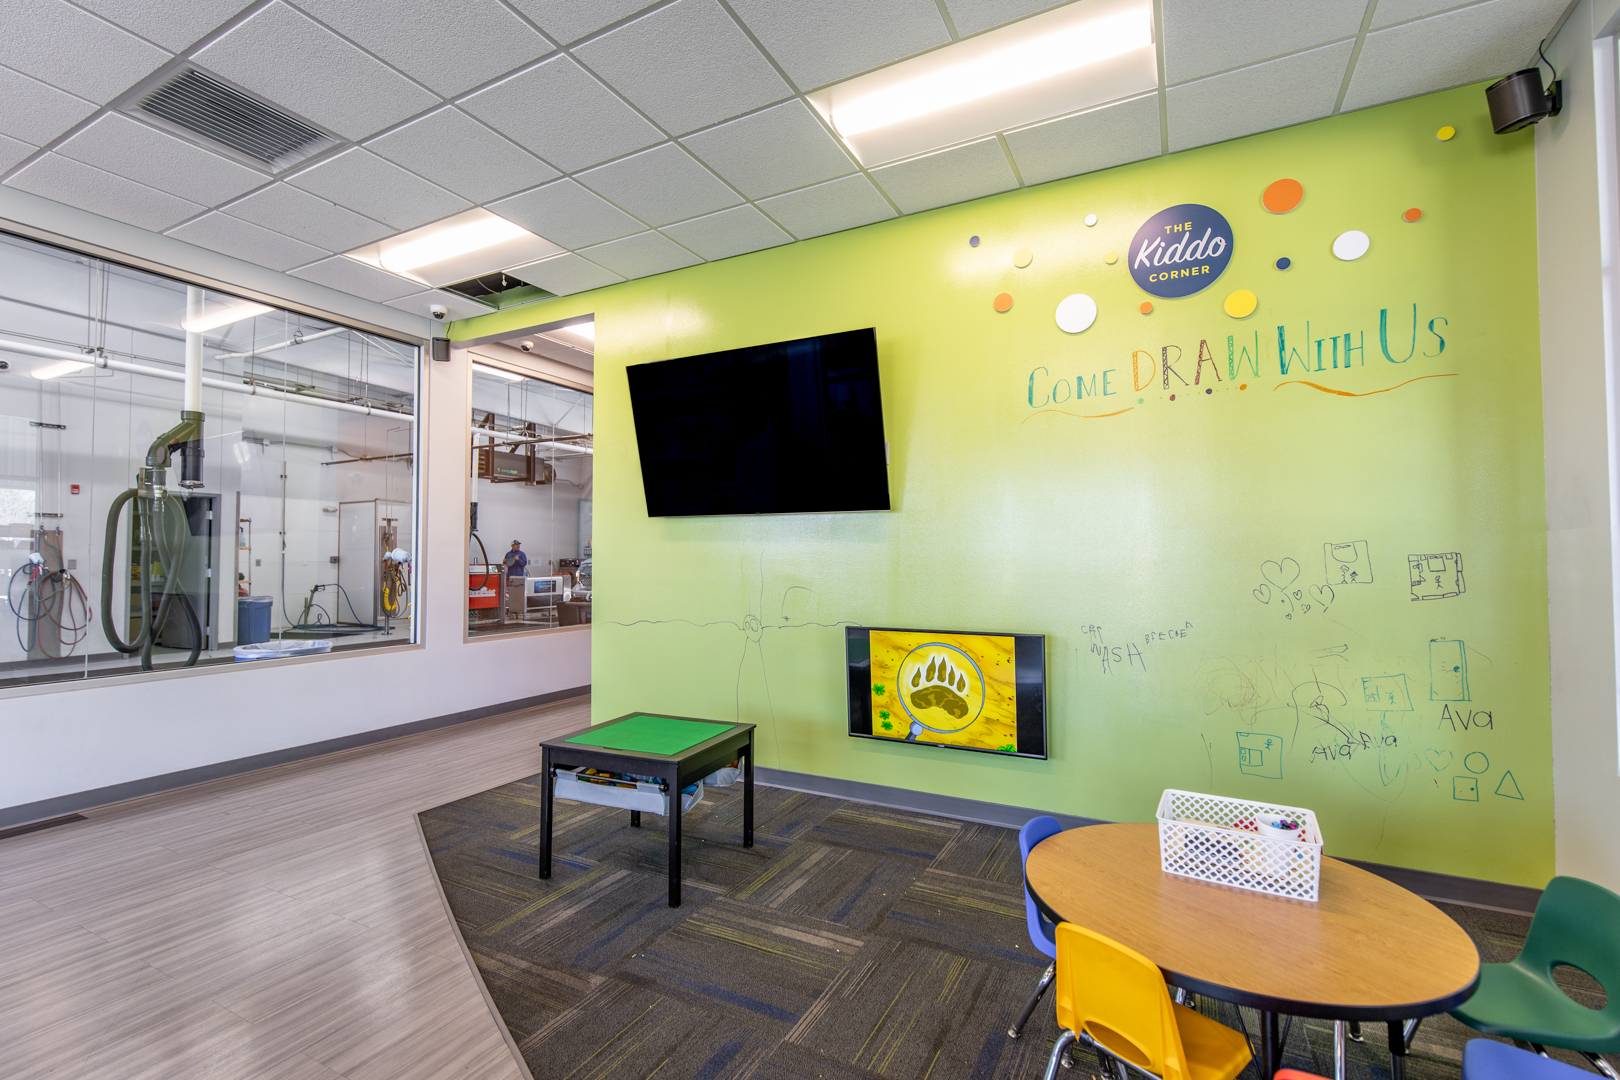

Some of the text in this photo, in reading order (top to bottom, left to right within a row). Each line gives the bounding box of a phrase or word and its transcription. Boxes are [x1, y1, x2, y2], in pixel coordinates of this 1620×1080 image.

[1164, 221, 1193, 235] THE
[1133, 226, 1227, 270] Kiddo
[1149, 265, 1211, 283] CORNER
[1028, 302, 1449, 409] COME DRAW WITH US
[1090, 642, 1147, 677] WASH
[1437, 703, 1494, 732] Ava
